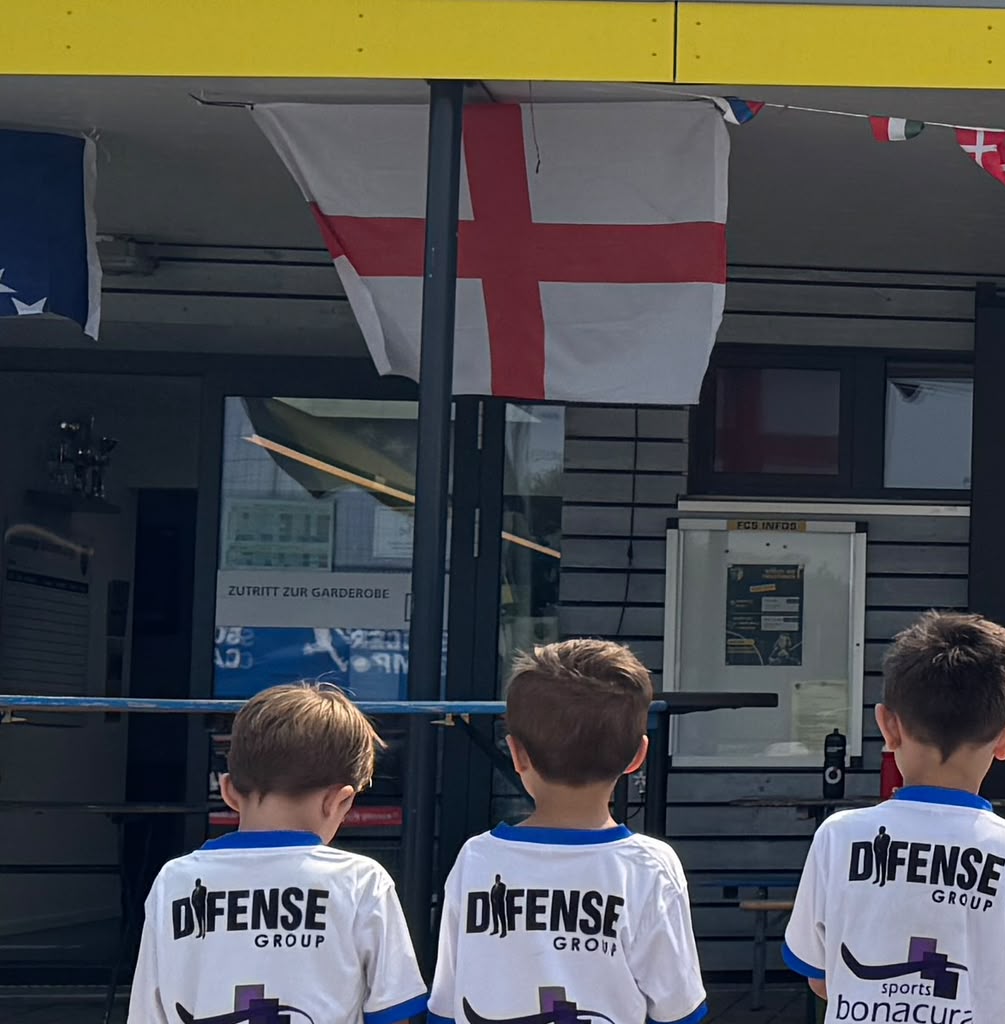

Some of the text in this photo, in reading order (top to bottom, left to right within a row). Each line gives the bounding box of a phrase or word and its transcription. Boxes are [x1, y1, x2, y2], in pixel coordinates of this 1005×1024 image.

[228, 585, 390, 599] ZUTRITT ZUR GARDEROBE
[932, 889, 993, 912] GROUP
[255, 934, 325, 949] GROUP
[553, 936, 616, 957] GROUP
[882, 981, 931, 997] sports
